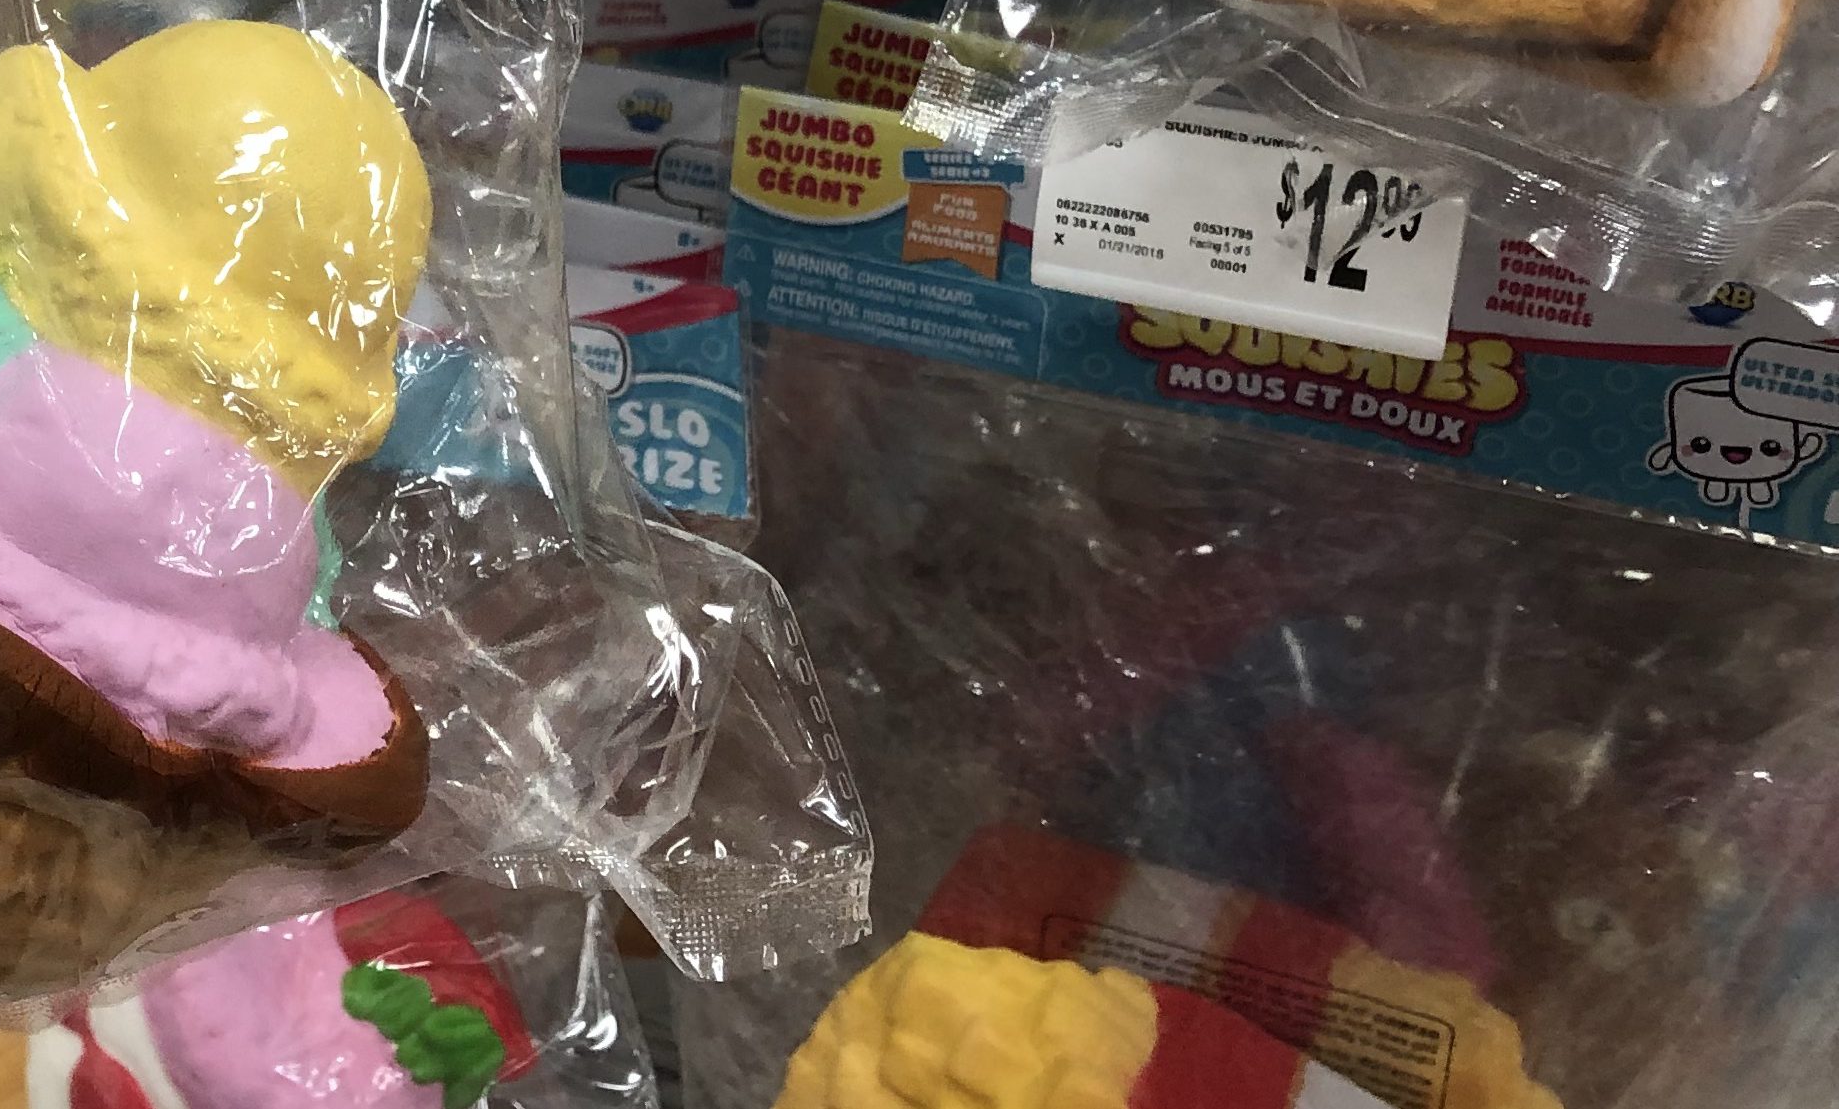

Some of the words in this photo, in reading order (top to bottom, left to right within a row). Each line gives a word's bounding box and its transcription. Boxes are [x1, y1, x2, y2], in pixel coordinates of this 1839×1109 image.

[842, 22, 931, 62] JUMB
[829, 47, 923, 86] SQUIS
[760, 108, 875, 149] JUMBO
[746, 135, 882, 180] SQUISHIE
[757, 166, 865, 207] GÉANT
[1054, 231, 1065, 245] X
[1102, 221, 1112, 233] A
[772, 248, 854, 281] WARNING:
[1210, 258, 1247, 274] 00001
[767, 285, 859, 318] ATTENTION:
[1497, 277, 1588, 308] FORMULE
[1712, 282, 1755, 311] RB
[1743, 358, 1814, 383] ULTRA
[1168, 363, 1286, 403] MOUS
[1294, 380, 1343, 411] ET
[1350, 393, 1466, 444] DOUX
[1740, 374, 1839, 404] ULTRADO
[617, 401, 710, 448] SLO
